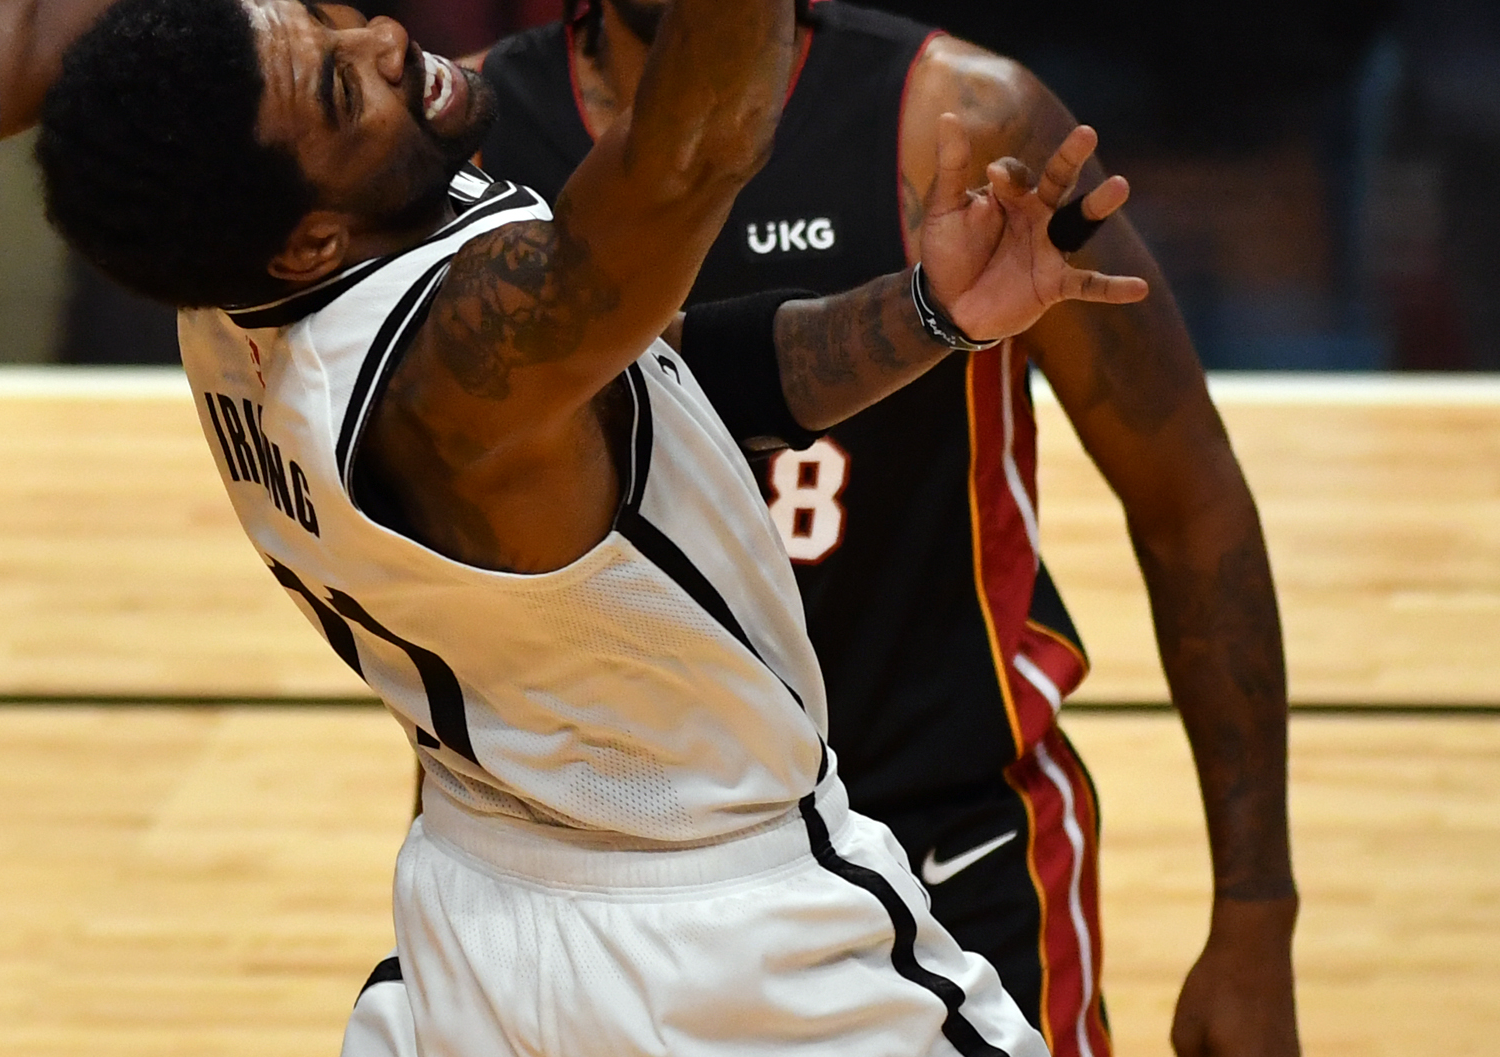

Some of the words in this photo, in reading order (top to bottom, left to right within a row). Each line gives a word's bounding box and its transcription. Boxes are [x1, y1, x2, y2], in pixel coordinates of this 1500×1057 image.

[747, 217, 836, 255] UKG
[204, 392, 321, 539] IRVNG
[768, 435, 850, 565] 8
